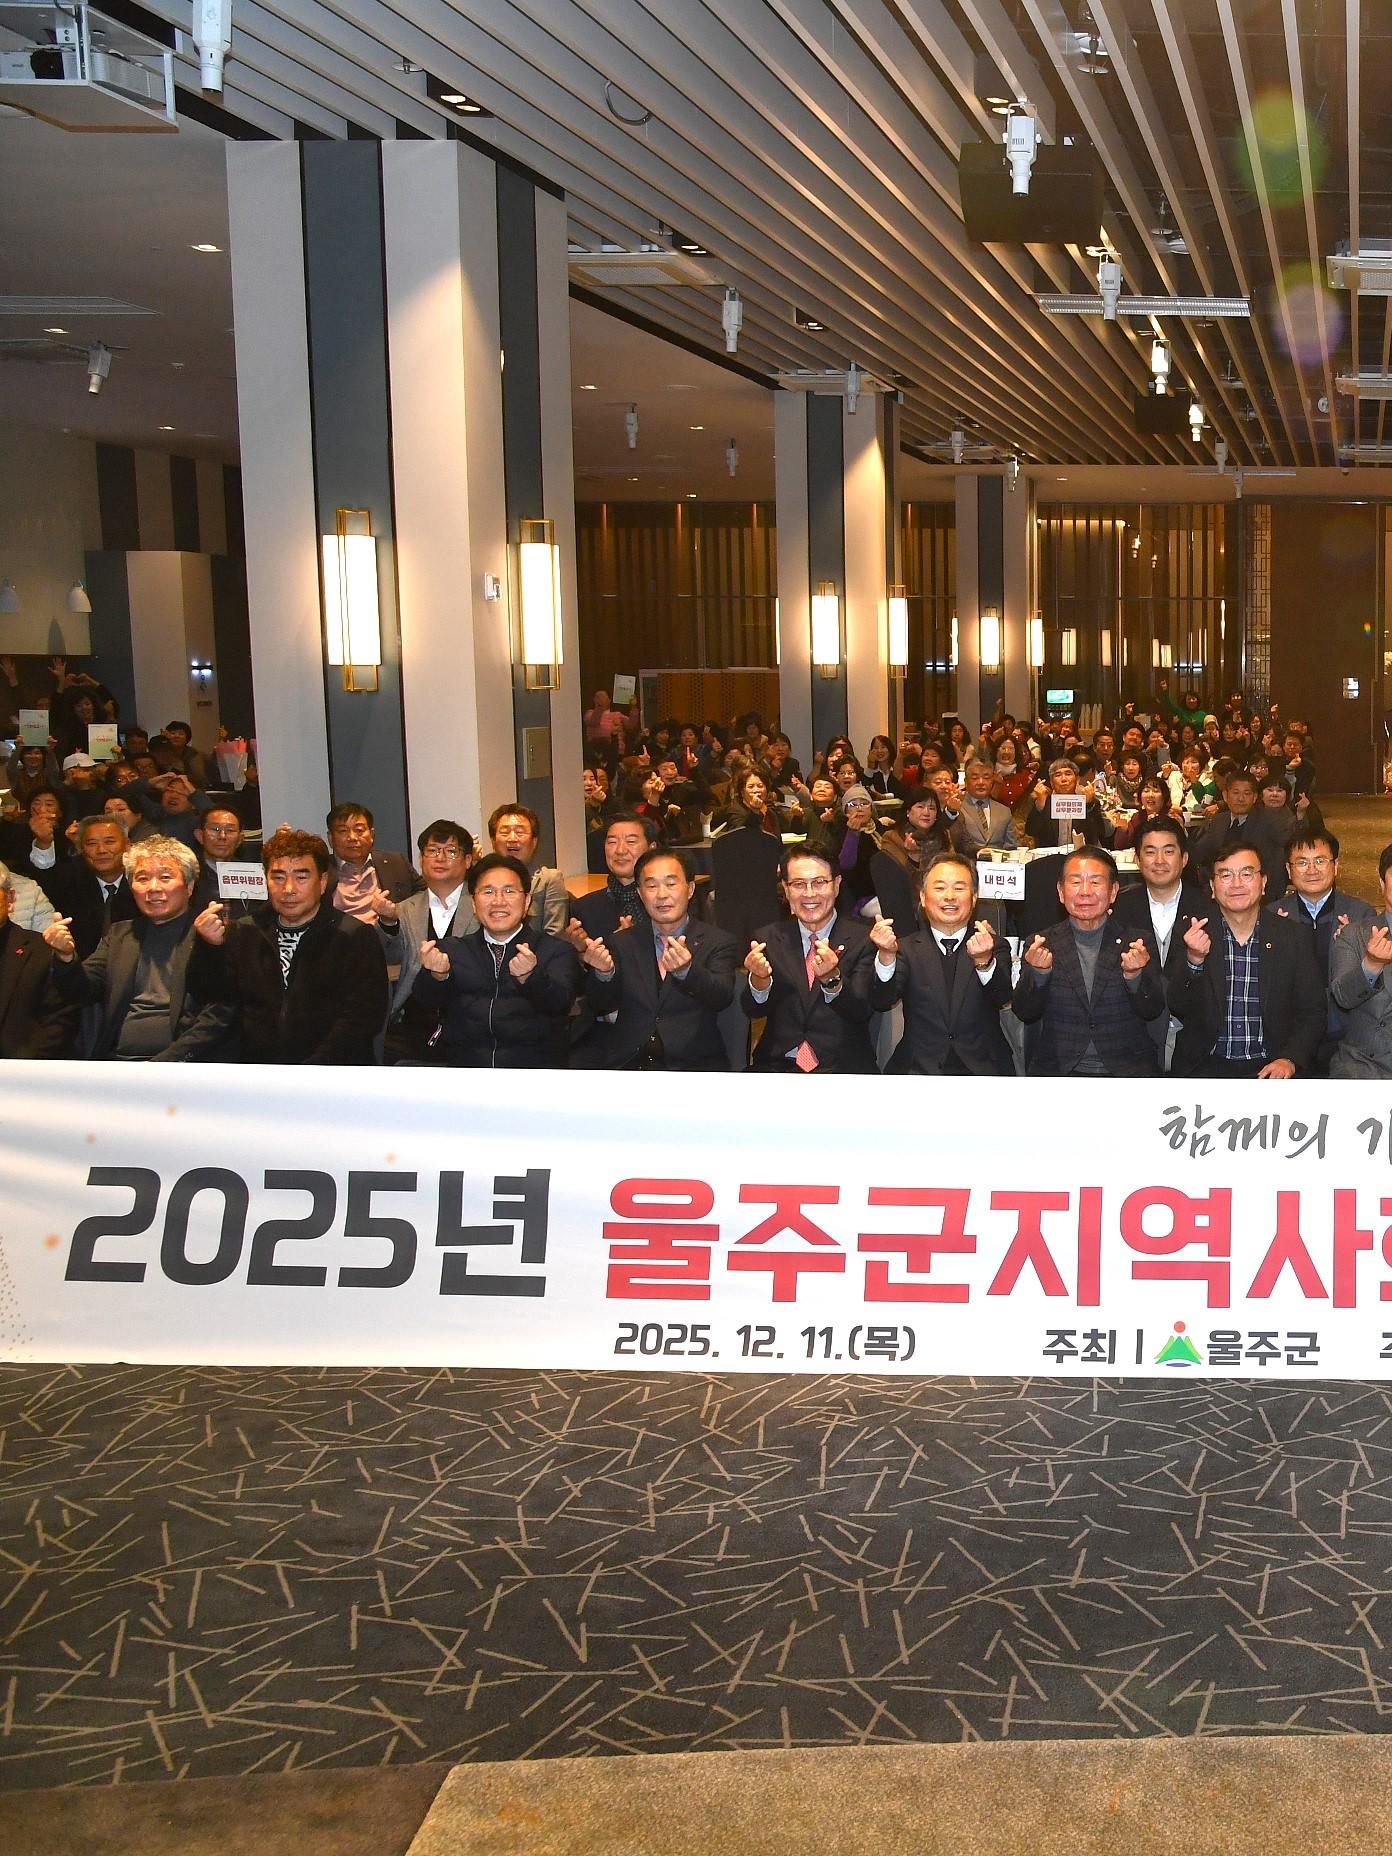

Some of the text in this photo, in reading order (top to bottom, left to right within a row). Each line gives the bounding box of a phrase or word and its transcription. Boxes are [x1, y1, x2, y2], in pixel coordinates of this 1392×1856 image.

[222, 875, 264, 886] 읍면위원장
[984, 874, 1017, 886] 내빈석
[1159, 1104, 1329, 1160] 함께의
[64, 1167, 551, 1297] 2025년
[614, 1322, 916, 1362] 2025. 12. 11.(목)
[1043, 1328, 1321, 1366] 주최 울주군
